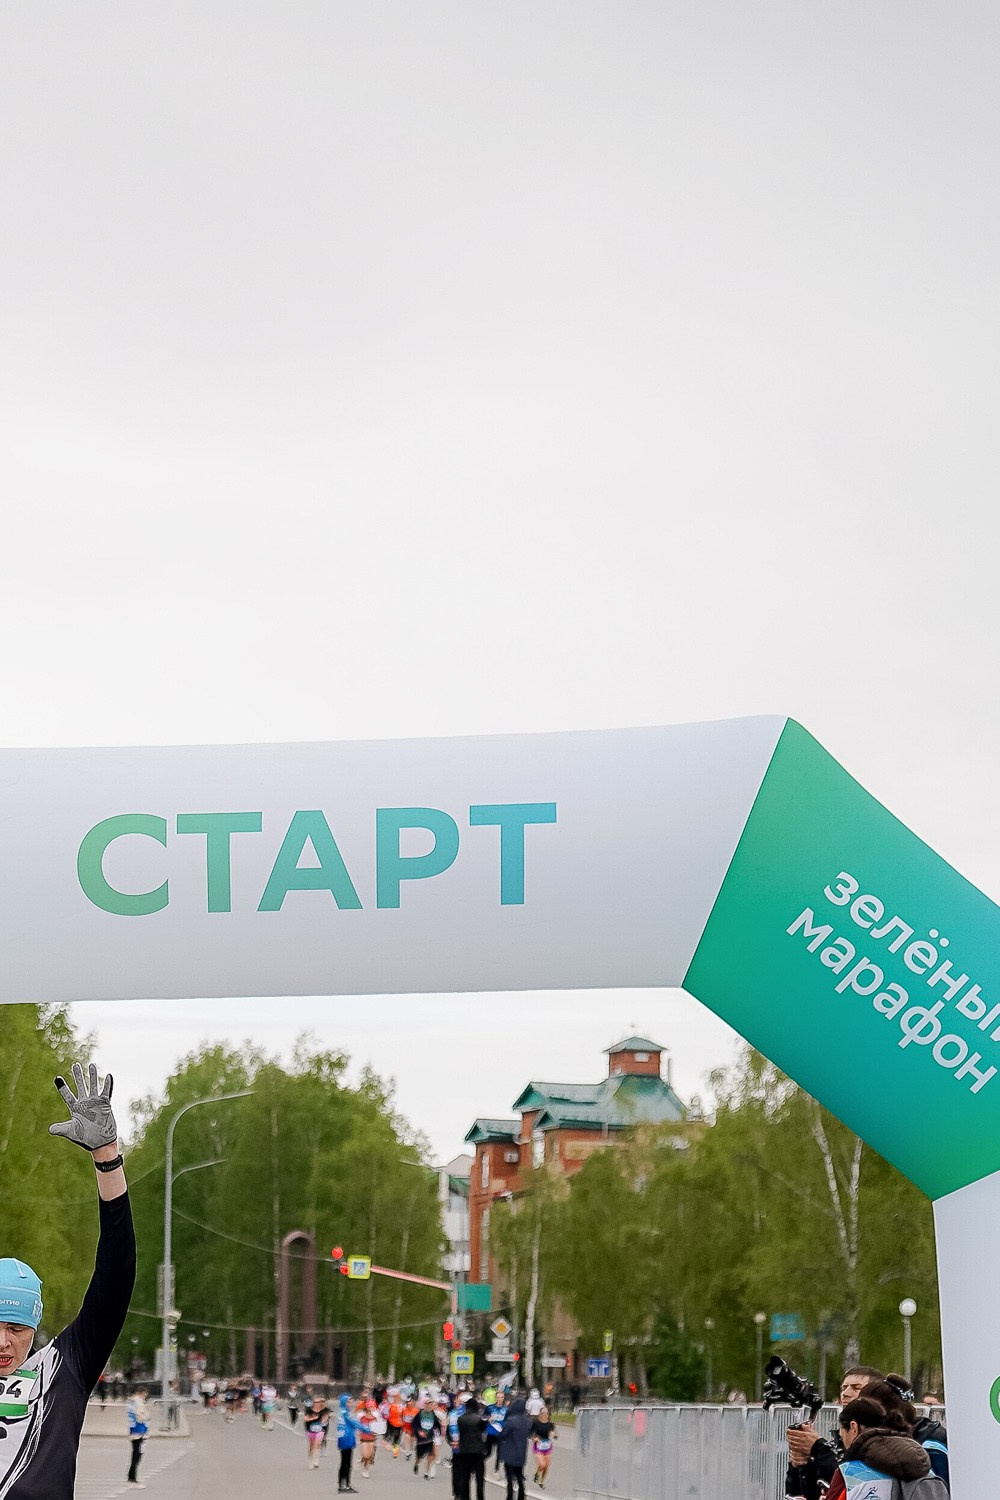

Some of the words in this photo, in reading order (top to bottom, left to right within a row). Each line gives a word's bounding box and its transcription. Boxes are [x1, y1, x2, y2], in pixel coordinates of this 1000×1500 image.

[77, 802, 557, 916] СТАРТ
[786, 906, 998, 1094] марафон
[823, 871, 1000, 1042] зелёны
